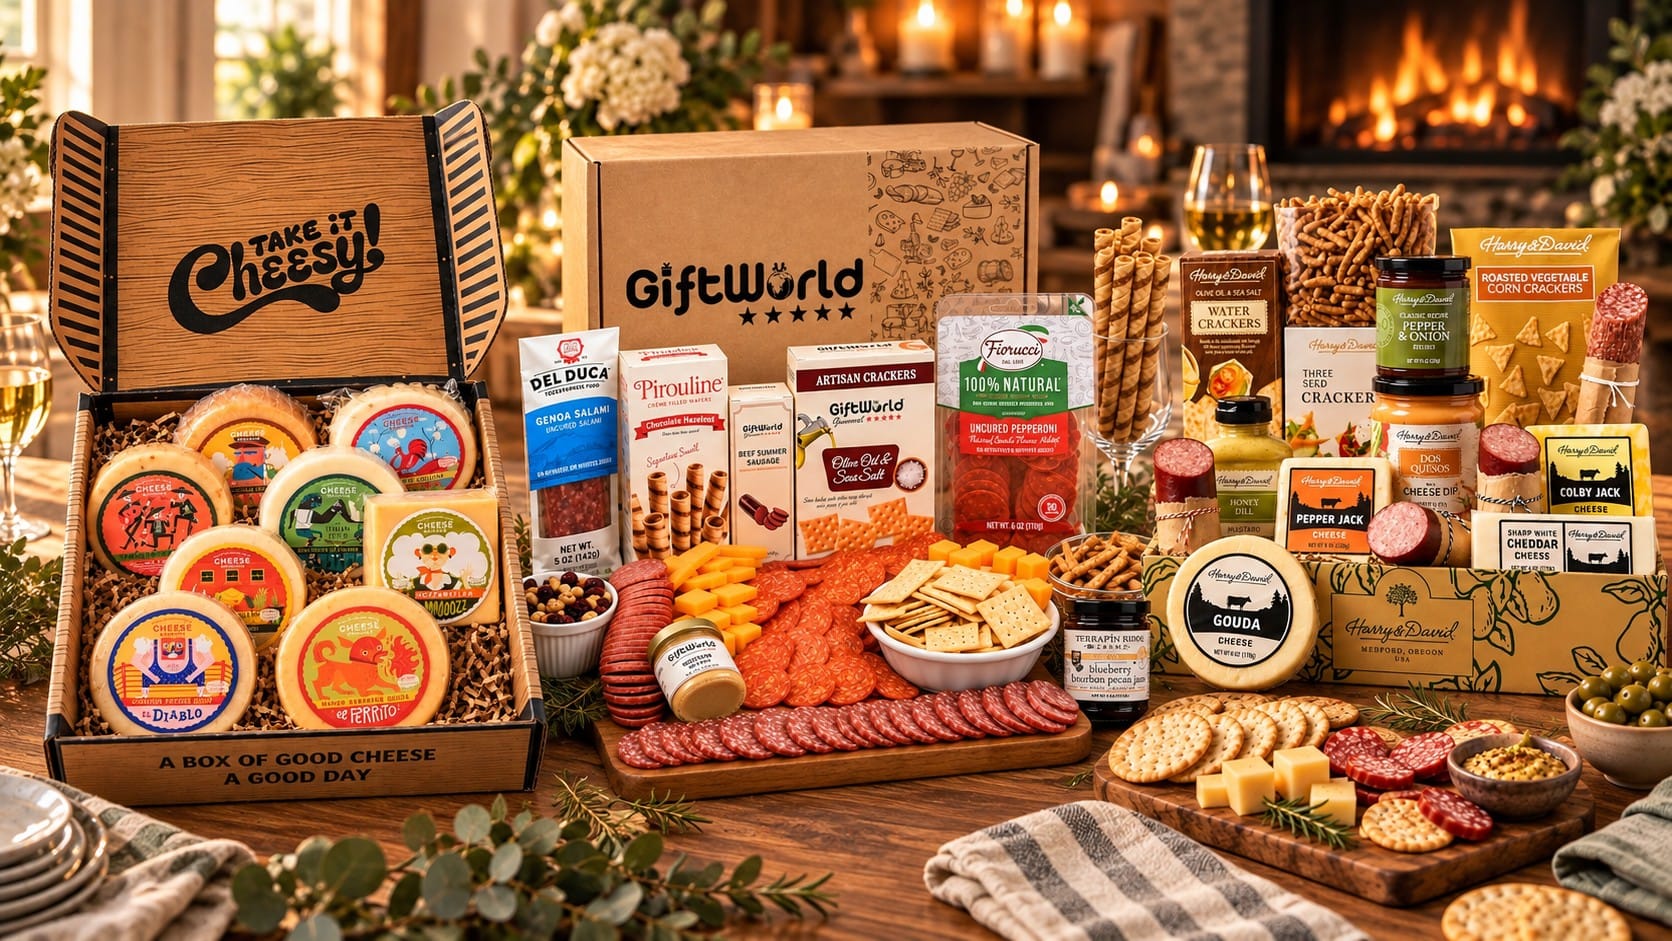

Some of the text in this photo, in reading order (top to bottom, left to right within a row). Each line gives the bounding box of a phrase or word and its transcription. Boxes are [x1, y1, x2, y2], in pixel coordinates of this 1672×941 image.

[248, 219, 322, 256] TAKE
[1482, 272, 1589, 282] ROASTED VEGETABLE
[626, 258, 863, 316] GiftWorld
[1246, 288, 1262, 296] SALT
[1487, 283, 1583, 294] CORN CRACKERS
[1208, 306, 1250, 316] WATER
[1198, 318, 1261, 330] CRACKERS
[1403, 321, 1446, 331] PEPPER
[1398, 331, 1450, 342] & ONION
[984, 339, 1041, 359] Fiorucci
[529, 372, 562, 391] DEL
[565, 366, 609, 382] DUCA
[816, 369, 917, 386] ARTISAN CRACKERS
[1302, 369, 1333, 378] THREE
[633, 376, 723, 400] Pirouline
[964, 377, 1061, 393] 100% NATURAL
[829, 398, 905, 417] GiftWorld
[536, 405, 610, 426] GENOA SALAMI
[970, 423, 1057, 434] UNCURED PEPPERONI
[738, 449, 756, 458] BEEF
[880, 452, 893, 465] &
[1420, 454, 1441, 464] DOS
[1403, 486, 1458, 497] CHEESE DIP
[1560, 487, 1621, 498] COLBY JACK
[1235, 507, 1254, 515] DILL
[1574, 505, 1608, 513] CHEESE
[417, 521, 453, 529] CHEESE
[1296, 514, 1364, 525] PEPPER JACK
[1533, 529, 1558, 538] WHITE
[560, 543, 577, 554] NET
[1507, 538, 1559, 550] CHEDDAR
[554, 557, 560, 566] 5
[562, 555, 573, 564] OZ
[153, 624, 192, 632] CHEESE
[339, 621, 380, 633] CHEESE
[1213, 614, 1261, 631] GOUDA
[1075, 633, 1120, 643] TERRAPIN
[1218, 636, 1253, 647] CHEESE
[1089, 663, 1131, 676] blueberry
[152, 708, 203, 722] DIABLO
[159, 748, 436, 769] A BOX OF GOOD CHEESE
[224, 768, 372, 786] A GOOD DAY
